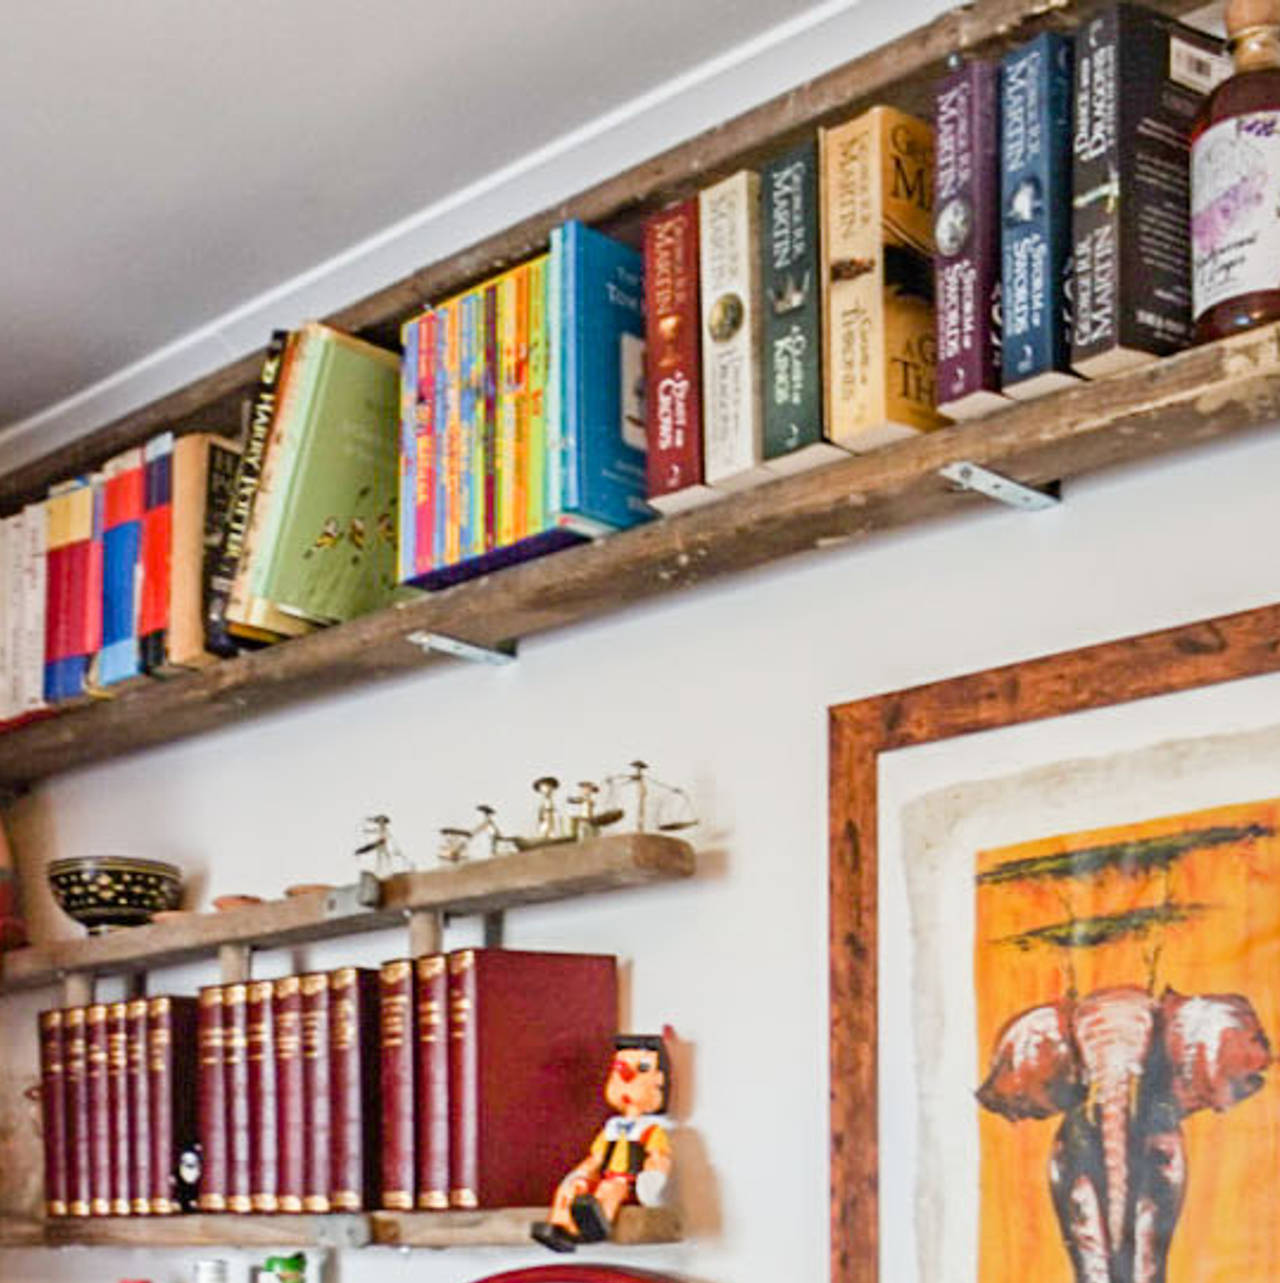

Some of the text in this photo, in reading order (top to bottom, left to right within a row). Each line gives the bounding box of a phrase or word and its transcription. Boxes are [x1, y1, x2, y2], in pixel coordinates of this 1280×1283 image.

[936, 89, 958, 201] MARTIN
[1004, 59, 1027, 172] MARTIN
[772, 168, 793, 269] MARTIN
[653, 220, 675, 315] MARTIN
[944, 264, 963, 359] SWORDS
[961, 269, 976, 332] STORM
[1012, 238, 1032, 335] SWORDS
[1030, 242, 1047, 310] STORM
[1091, 225, 1114, 340] MARTIN
[657, 377, 676, 450] CROWS
[773, 336, 792, 404] KINGS
[227, 391, 275, 559] HARRY POTTER
